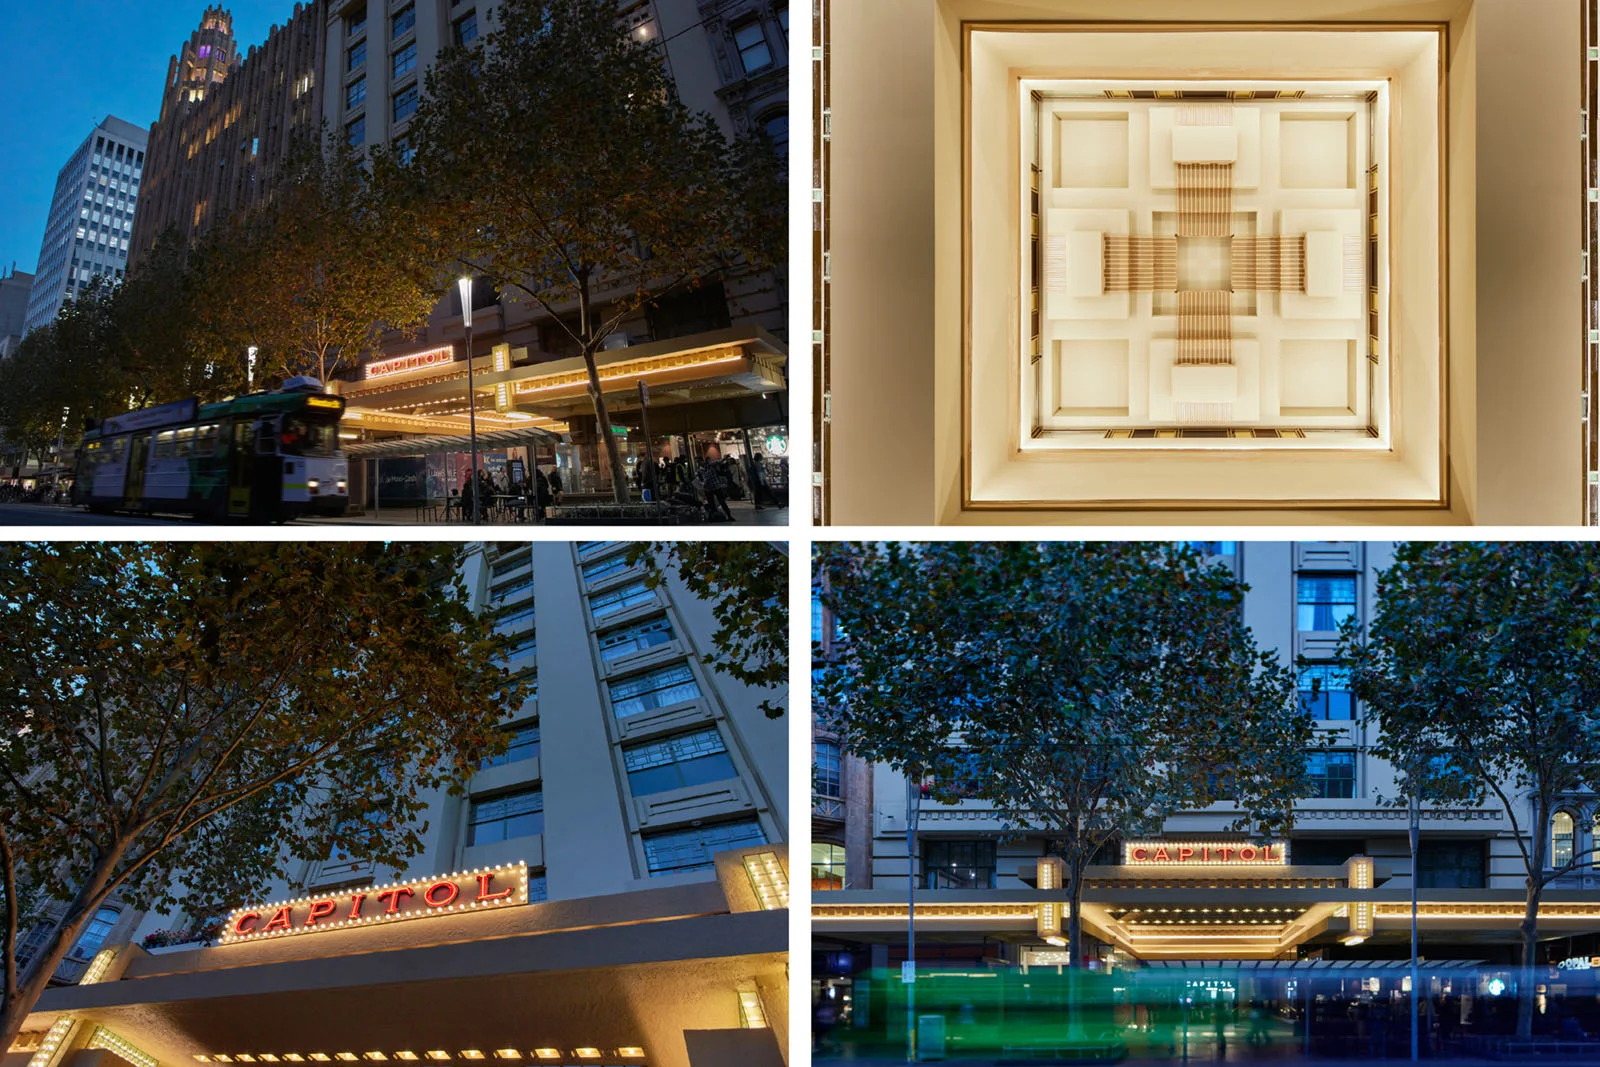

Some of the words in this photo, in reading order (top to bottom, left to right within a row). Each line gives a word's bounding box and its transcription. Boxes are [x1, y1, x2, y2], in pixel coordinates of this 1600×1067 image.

[370, 350, 449, 376] CAPITOL
[1132, 845, 1280, 862] CAPITOL
[233, 873, 514, 935] CAPITOL
